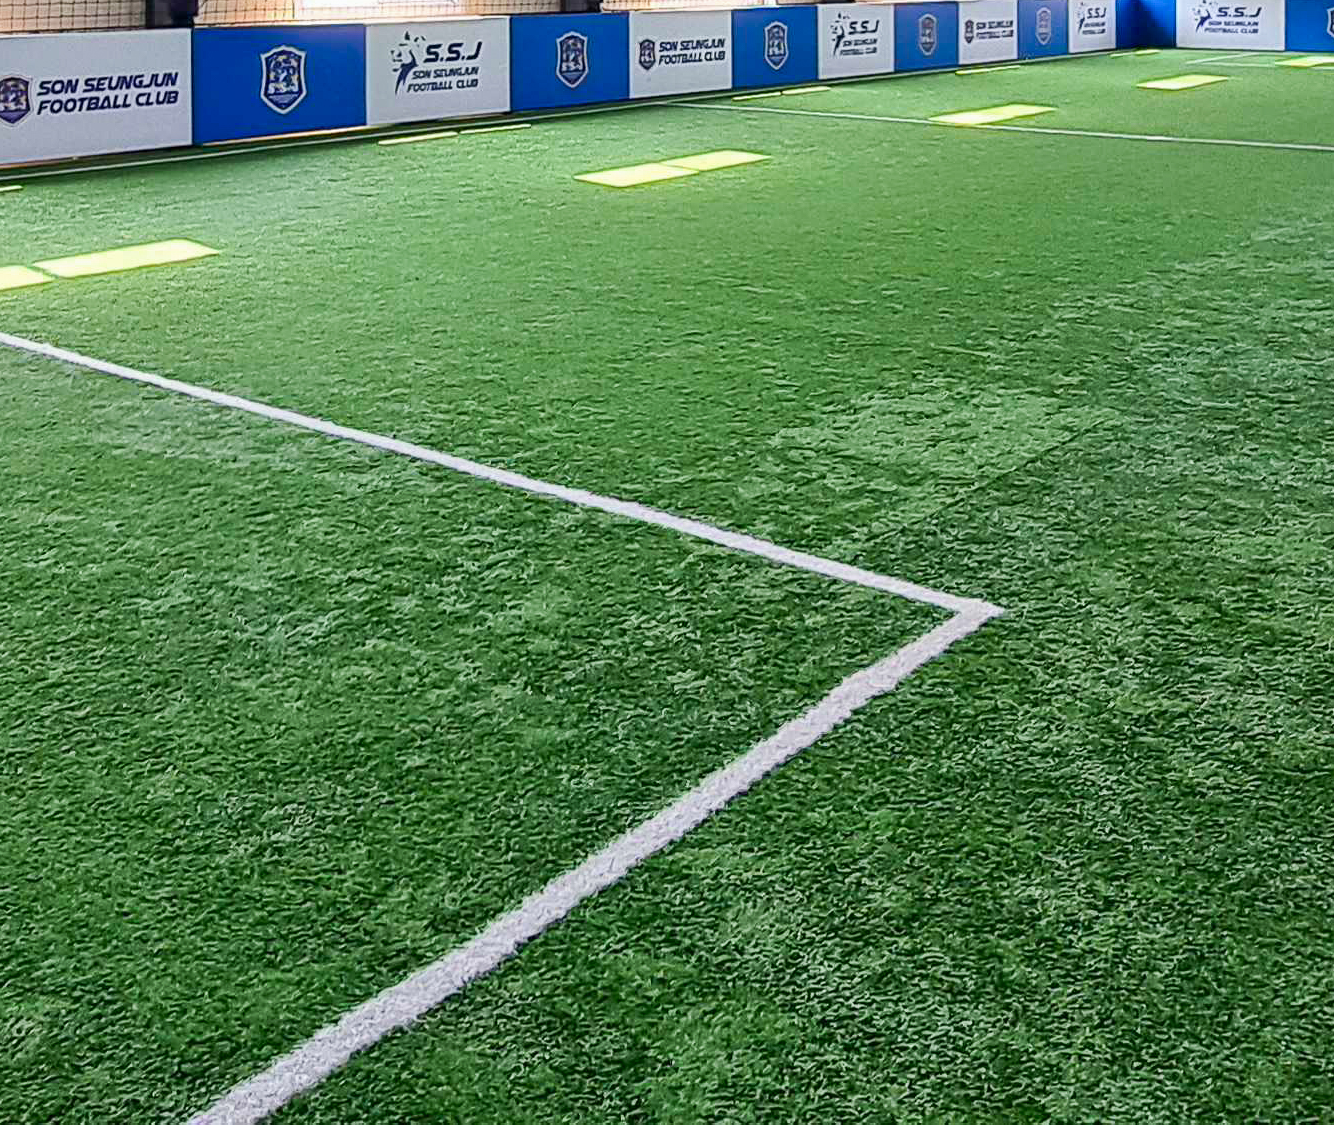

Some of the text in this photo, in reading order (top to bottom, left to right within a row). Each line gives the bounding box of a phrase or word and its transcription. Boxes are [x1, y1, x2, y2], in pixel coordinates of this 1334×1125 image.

[1216, 6, 1262, 18] S.S.J
[423, 41, 483, 63] S.S.J
[36, 72, 179, 96] SON SEUNGJUN
[36, 94, 131, 115] FOOTBALL
[135, 90, 179, 107] CLUB
